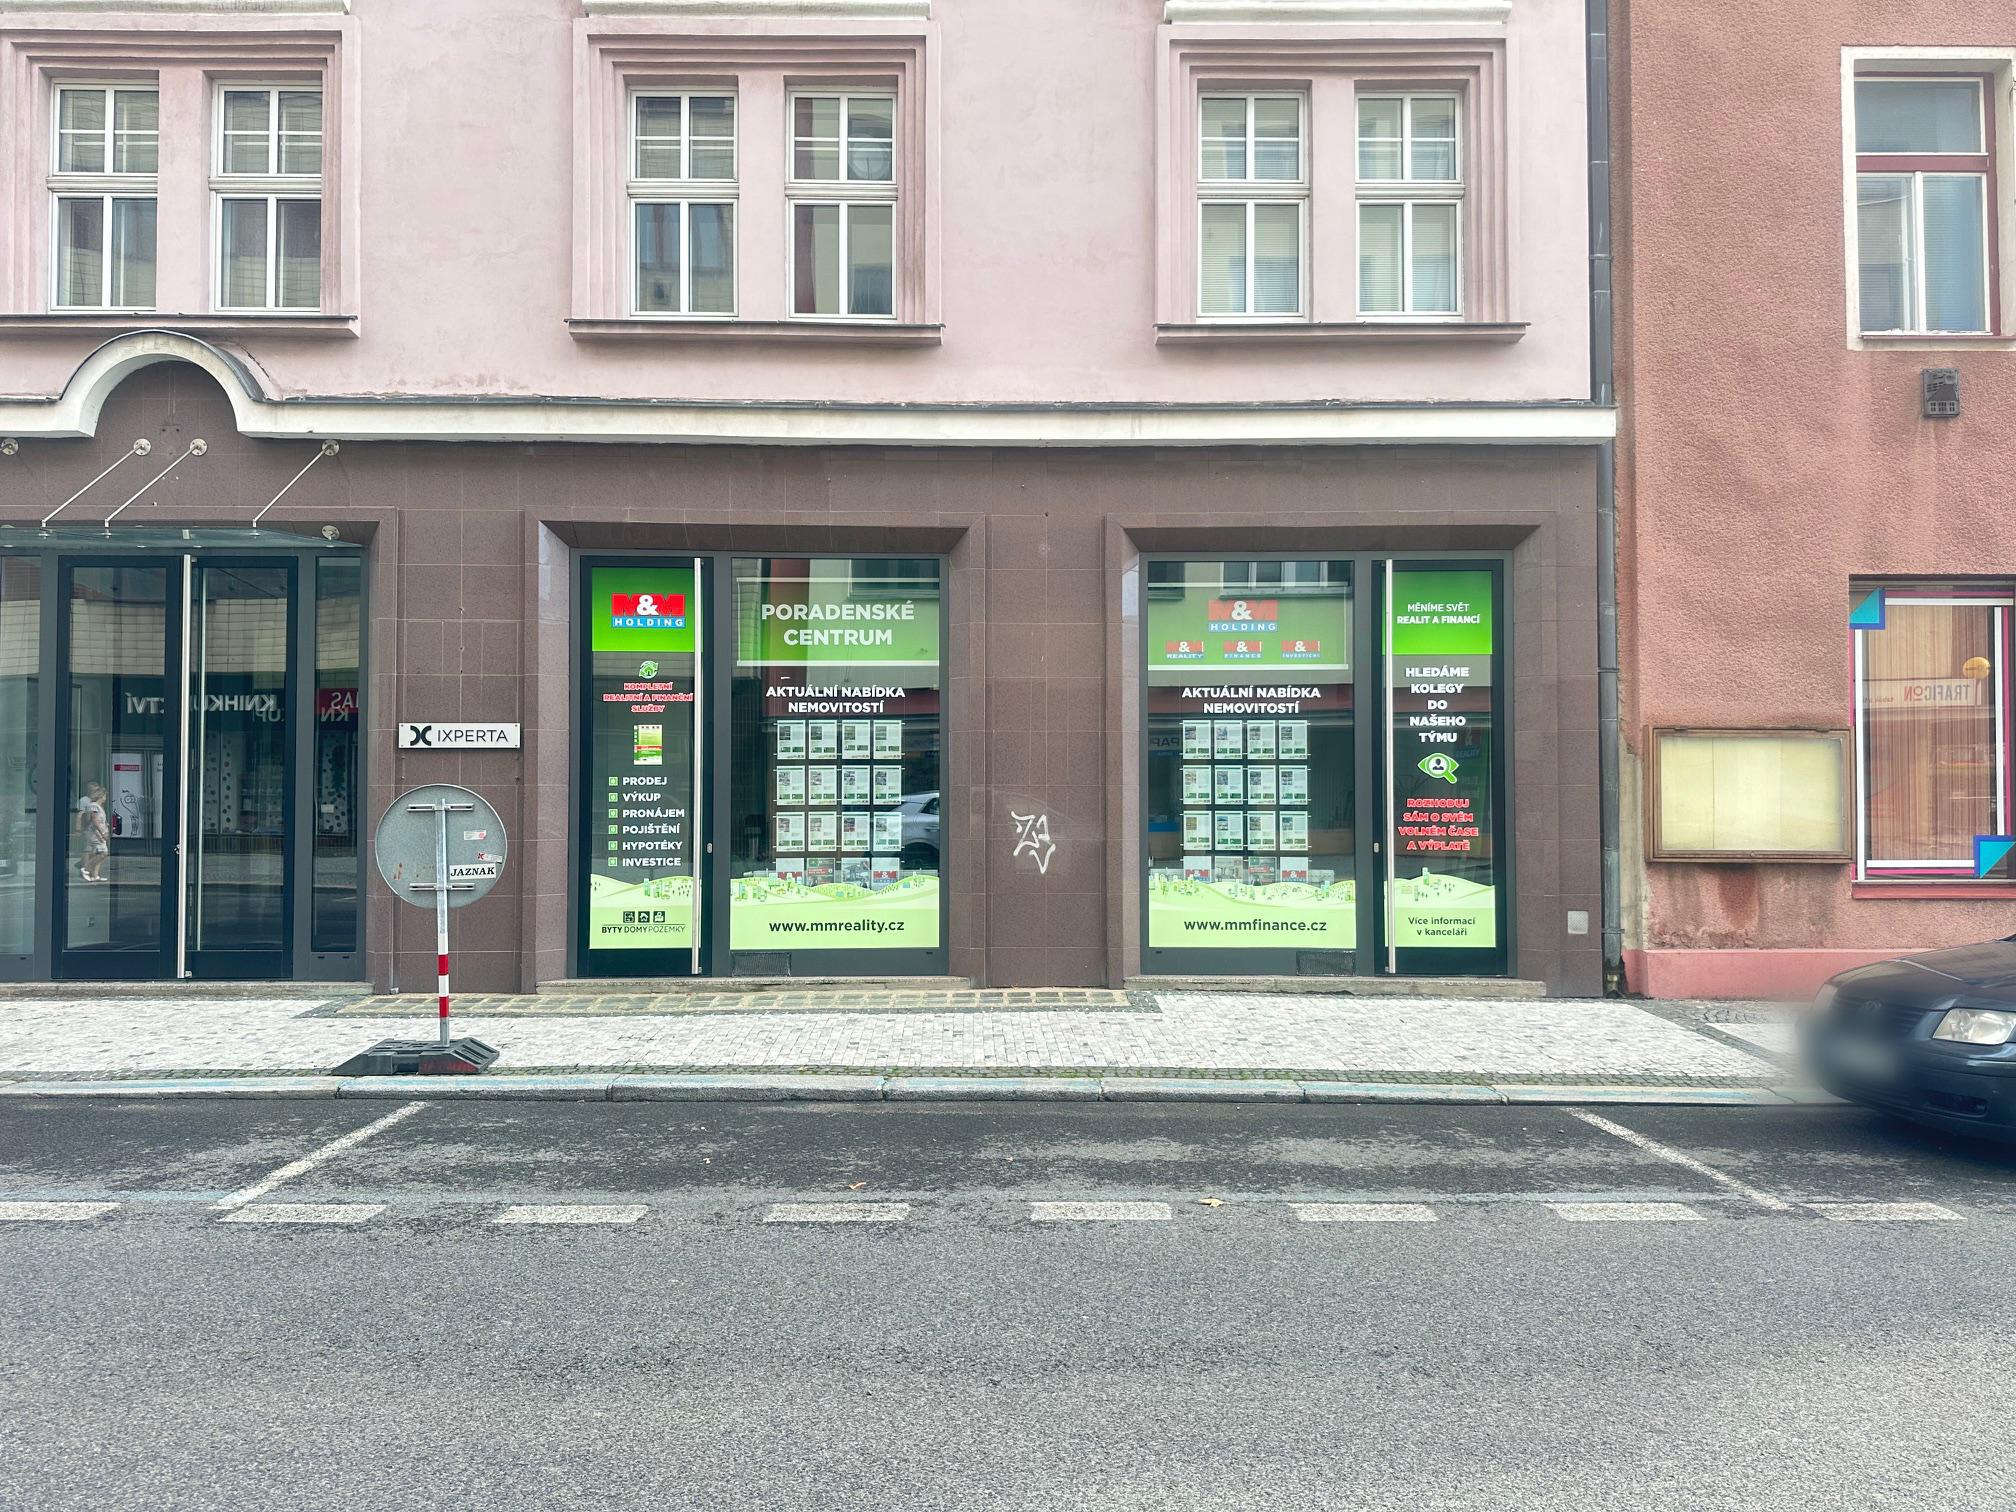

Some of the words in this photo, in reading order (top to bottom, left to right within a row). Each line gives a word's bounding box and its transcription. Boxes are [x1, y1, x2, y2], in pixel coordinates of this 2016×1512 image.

[761, 600, 915, 620] PORADENSKÉ
[1407, 602, 1443, 612] MĚNÍME
[1446, 602, 1470, 612] SVĚT
[614, 618, 684, 627] HOLDING
[1396, 615, 1429, 624] REALIT
[1432, 616, 1439, 624] A
[1441, 614, 1481, 624] FINANCÍ
[1210, 623, 1277, 631] HOLDING
[783, 629, 893, 646] CENTRUM
[1405, 665, 1470, 677] HLEDÁME
[623, 682, 673, 691] KOMPLETNÍ
[765, 684, 839, 697] AKTUÁLNÍ
[841, 684, 906, 697] NABÍDKA
[1181, 685, 1253, 698] AKTUÁLNÍ
[1256, 685, 1321, 698] NABÍDKA
[1410, 684, 1464, 694] KOLEGY
[602, 692, 643, 702] REALITNÍ
[644, 694, 650, 702] A
[651, 692, 694, 702] FINANČNÍ
[631, 703, 666, 713] SLUŽBY
[788, 700, 884, 713] NEMOVITOSTÍ
[1203, 701, 1300, 714] NEMOVITOSTÍ
[1427, 700, 1448, 710] DO
[1409, 714, 1466, 726] NAŠEHO
[437, 729, 508, 742] IXPERTA
[1418, 730, 1457, 743] TÝMU
[622, 776, 668, 786] PRODEJ
[622, 792, 662, 802] VÝKUP
[1406, 798, 1470, 808] ROZHODUJ
[622, 808, 685, 818] PRONÁJEM
[1402, 811, 1429, 822] SÁM
[1430, 813, 1440, 822] O
[1441, 811, 1474, 822] SVÉM
[622, 823, 681, 834] POJIŠTĚNÍ
[1397, 826, 1447, 836] VOLNÉM
[1448, 825, 1479, 836] ČASE
[622, 839, 683, 850] HYPOTÉKY
[1406, 841, 1416, 850] A
[1419, 839, 1470, 850] VÝPLATĚ
[622, 857, 682, 866] INVESTICE
[450, 867, 495, 877] JAZNAK
[1184, 919, 1327, 932] www.mmfinance.cz
[1408, 916, 1429, 925] Více
[1431, 916, 1476, 925] informací
[624, 925, 648, 933] DOMY
[648, 925, 686, 933] POZEMKY
[769, 919, 905, 933] www.mmreality.cz
[1425, 927, 1467, 936] kanceláři
